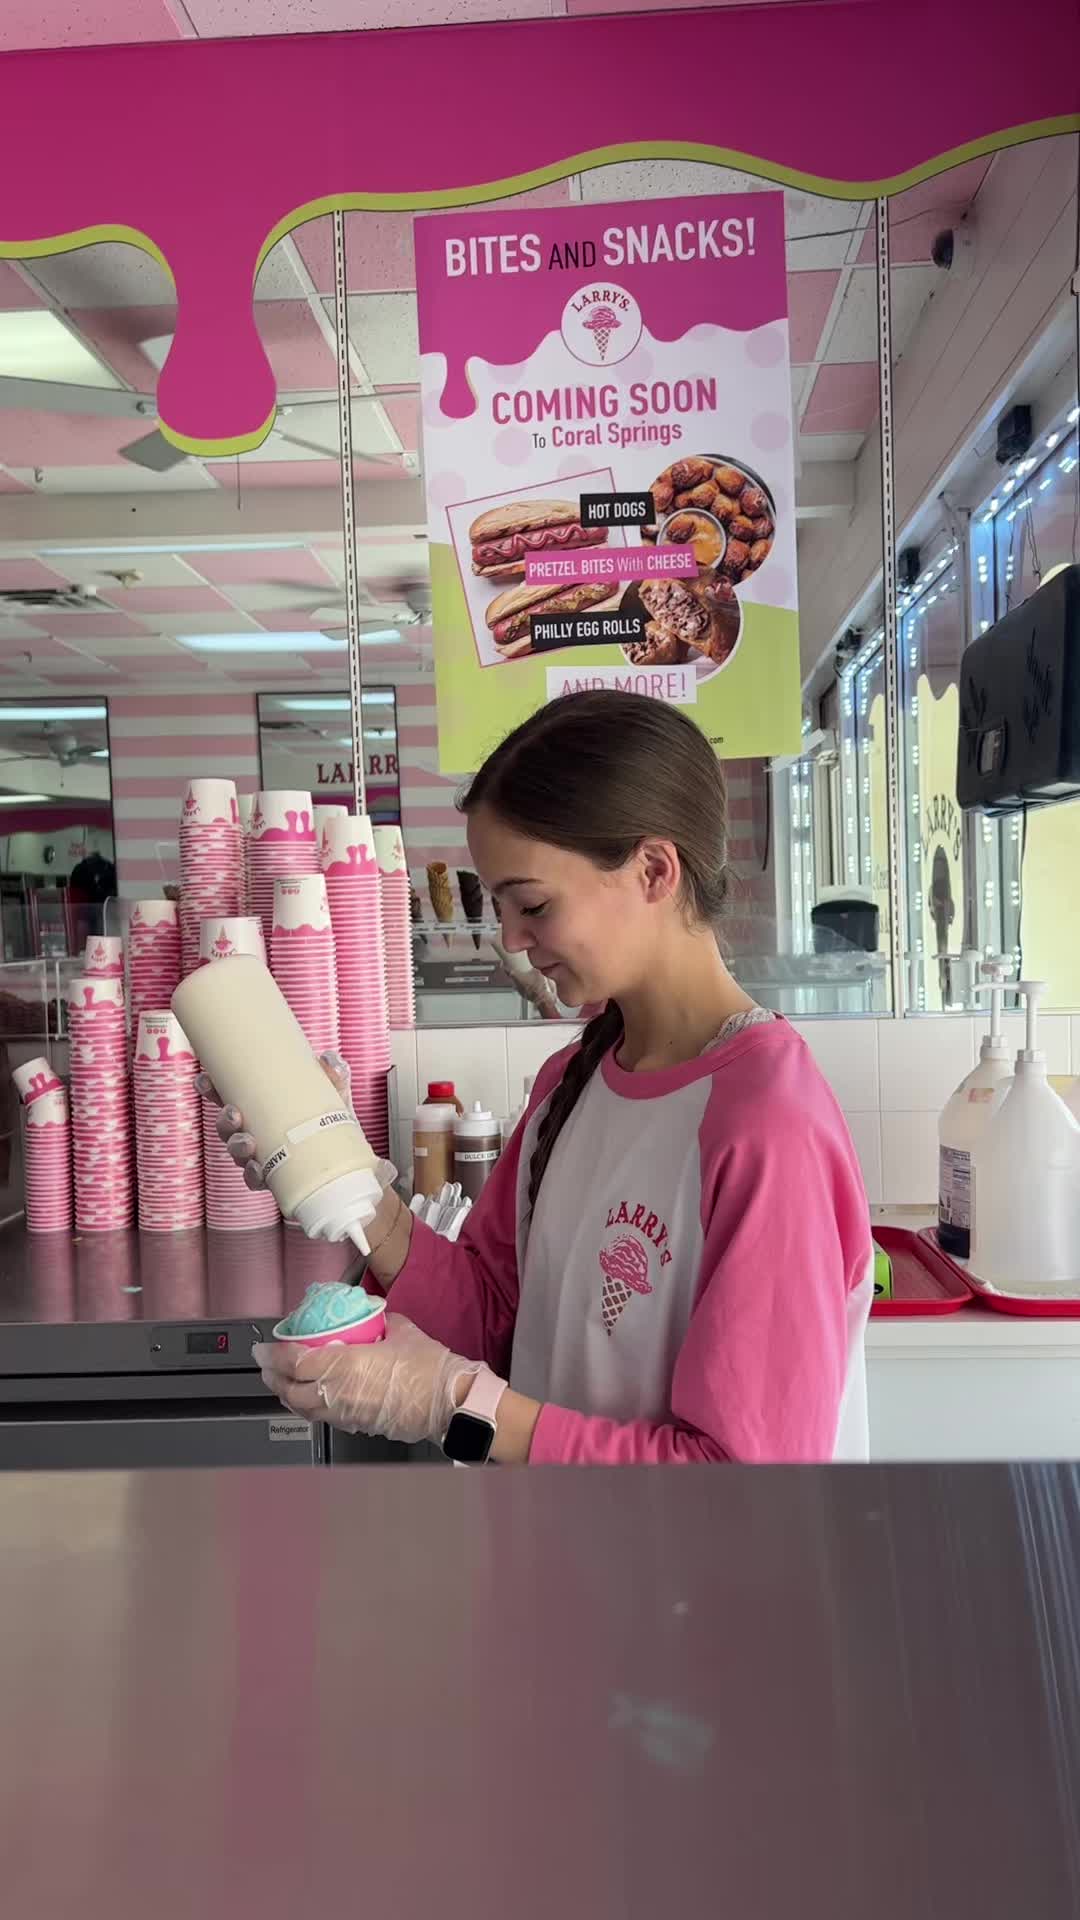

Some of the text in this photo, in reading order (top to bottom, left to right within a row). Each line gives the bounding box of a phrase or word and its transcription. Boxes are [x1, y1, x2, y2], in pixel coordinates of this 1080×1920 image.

[445, 217, 756, 277] BITES AND SNACKS!
[492, 377, 718, 424] COMING SOON
[532, 420, 682, 449] To Coral Springs
[588, 502, 647, 520] HOT DOGS
[529, 552, 692, 577] PRETZEL BITES With CHEESE
[534, 616, 641, 640] PHILLY EGG ROLLS
[320, 1111, 348, 1127] SYRUP
[605, 1201, 672, 1266] LARRY'S
[217, 1335, 226, 1349] 9
[270, 1425, 310, 1434] Refrigerator
